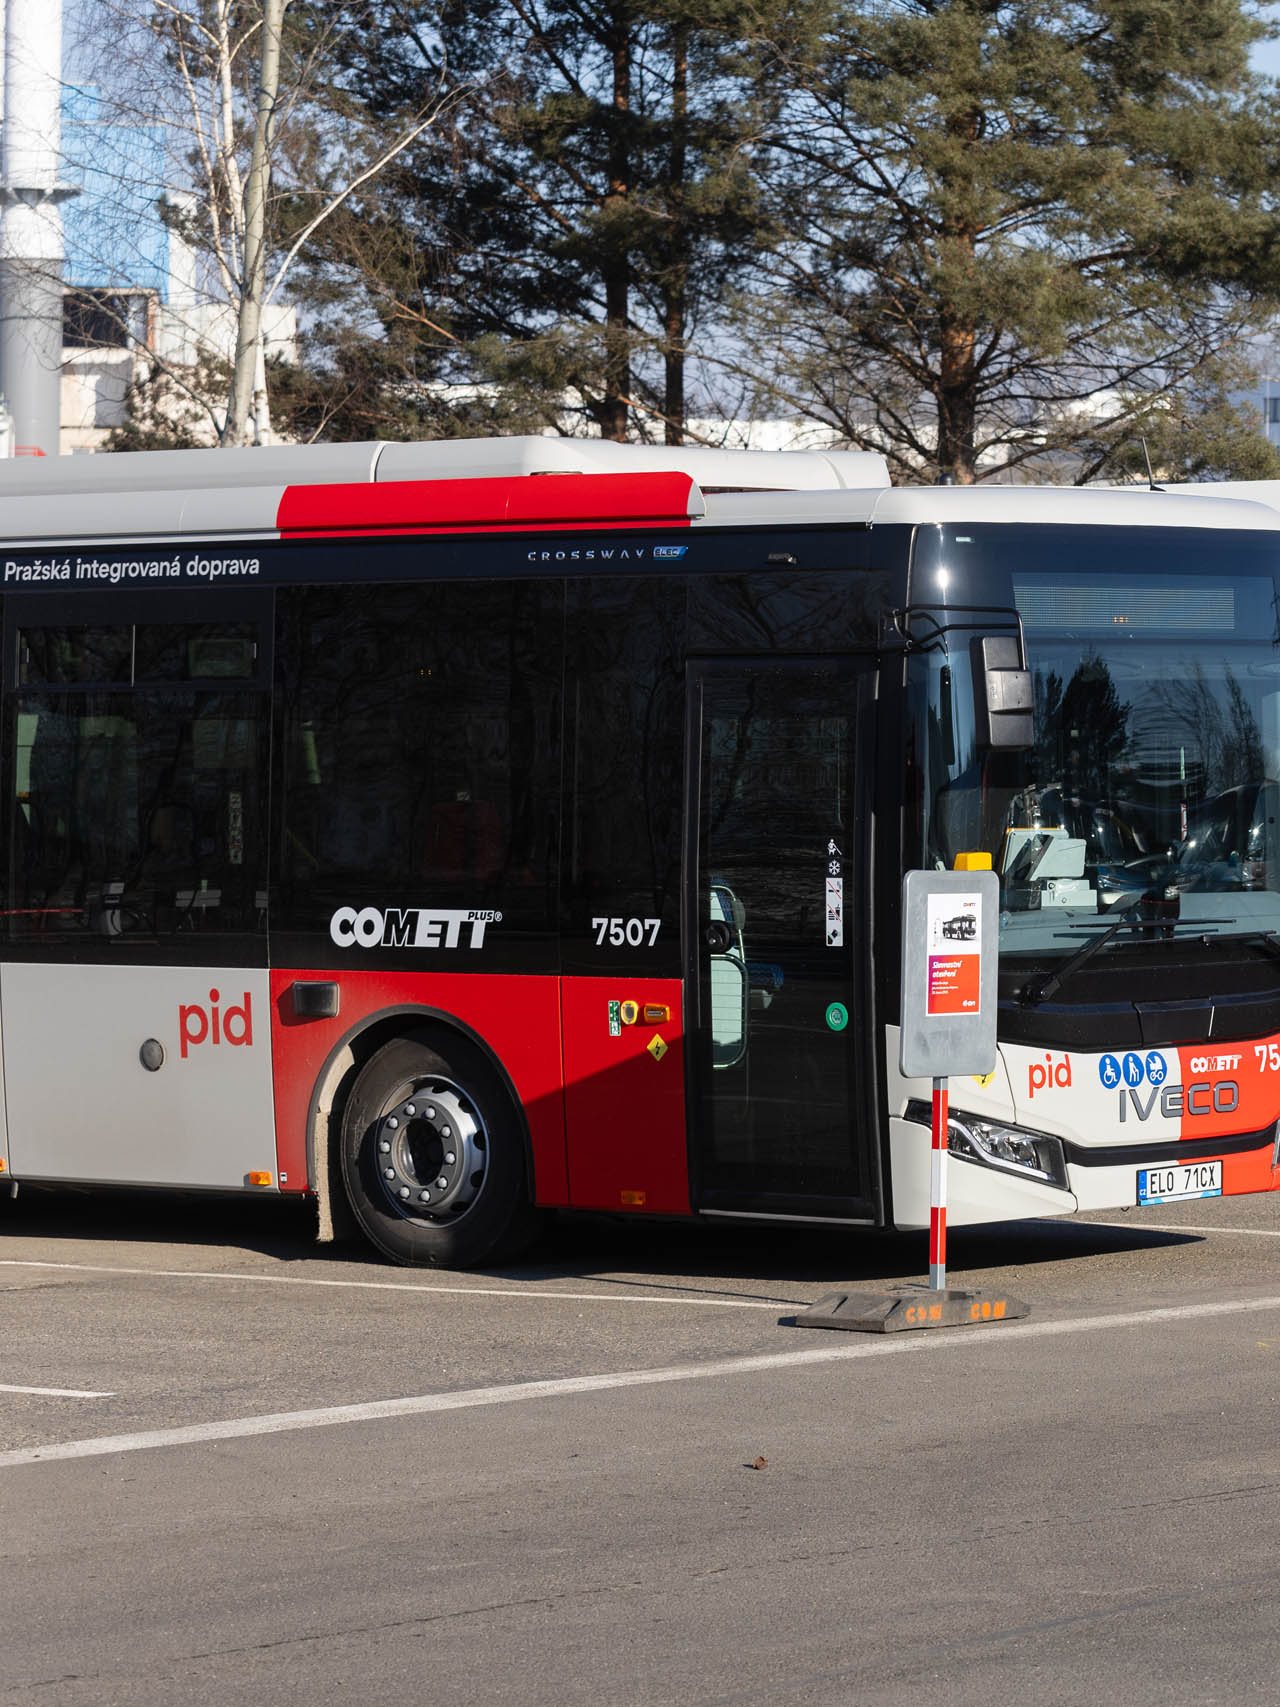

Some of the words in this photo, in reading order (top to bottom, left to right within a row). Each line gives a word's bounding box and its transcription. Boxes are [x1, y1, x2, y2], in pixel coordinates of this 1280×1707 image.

[4, 559, 71, 582] Pražská
[76, 555, 181, 583] integrovaná
[186, 555, 261, 581] doprava
[527, 549, 645, 561] CROSSWAY
[330, 906, 494, 949] COMETT
[591, 917, 662, 947] 7507
[178, 988, 253, 1059] pid
[1028, 1054, 1072, 1098] pid
[1190, 1055, 1242, 1073] COMETT
[1119, 1080, 1240, 1122] IVECO
[1184, 1165, 1215, 1190] 71CX
